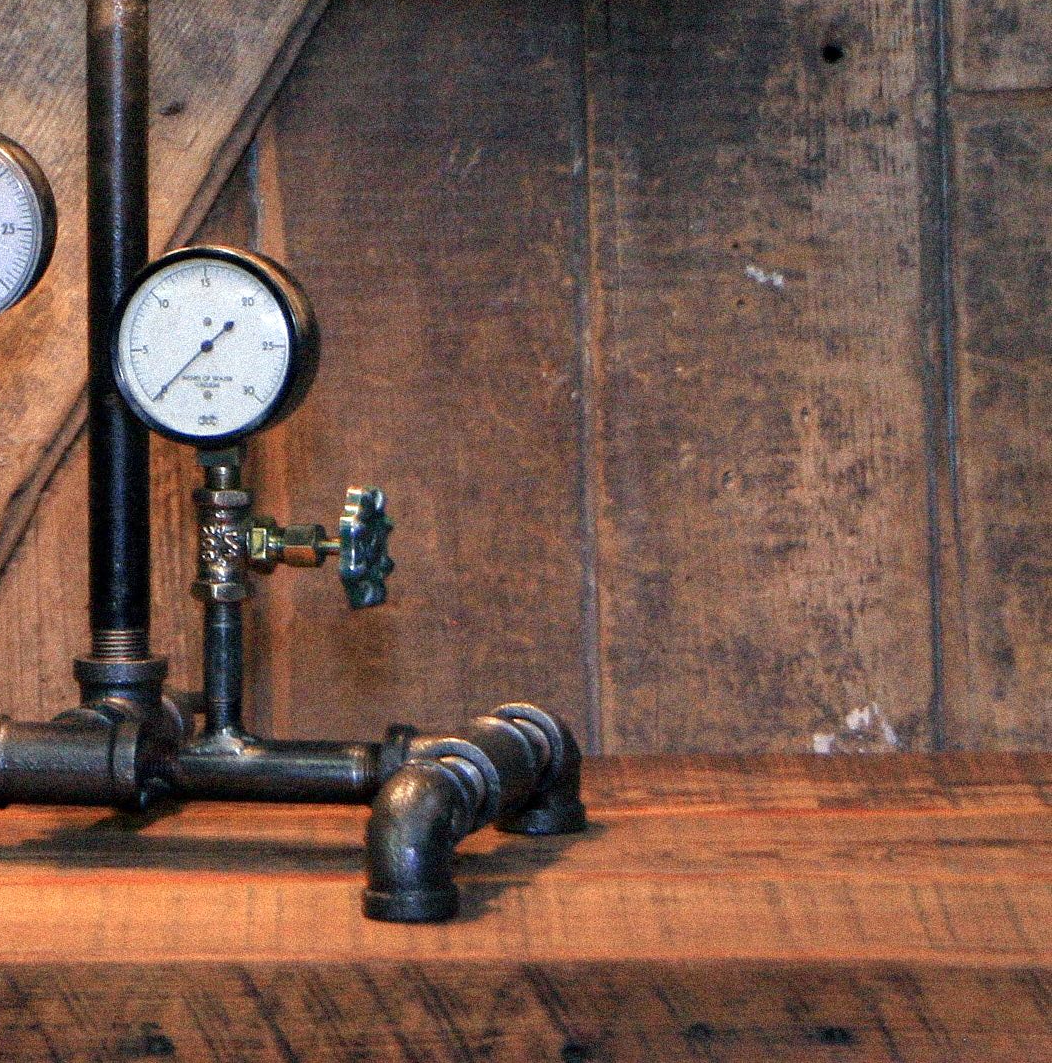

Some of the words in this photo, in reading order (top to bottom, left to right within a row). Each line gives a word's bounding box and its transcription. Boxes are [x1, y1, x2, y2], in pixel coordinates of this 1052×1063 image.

[1, 222, 15, 235] 25
[200, 278, 210, 288] 15
[159, 298, 169, 309] 10
[241, 296, 254, 307] 20
[142, 344, 149, 355] 5
[262, 341, 274, 351] 25
[244, 385, 255, 396] 30
